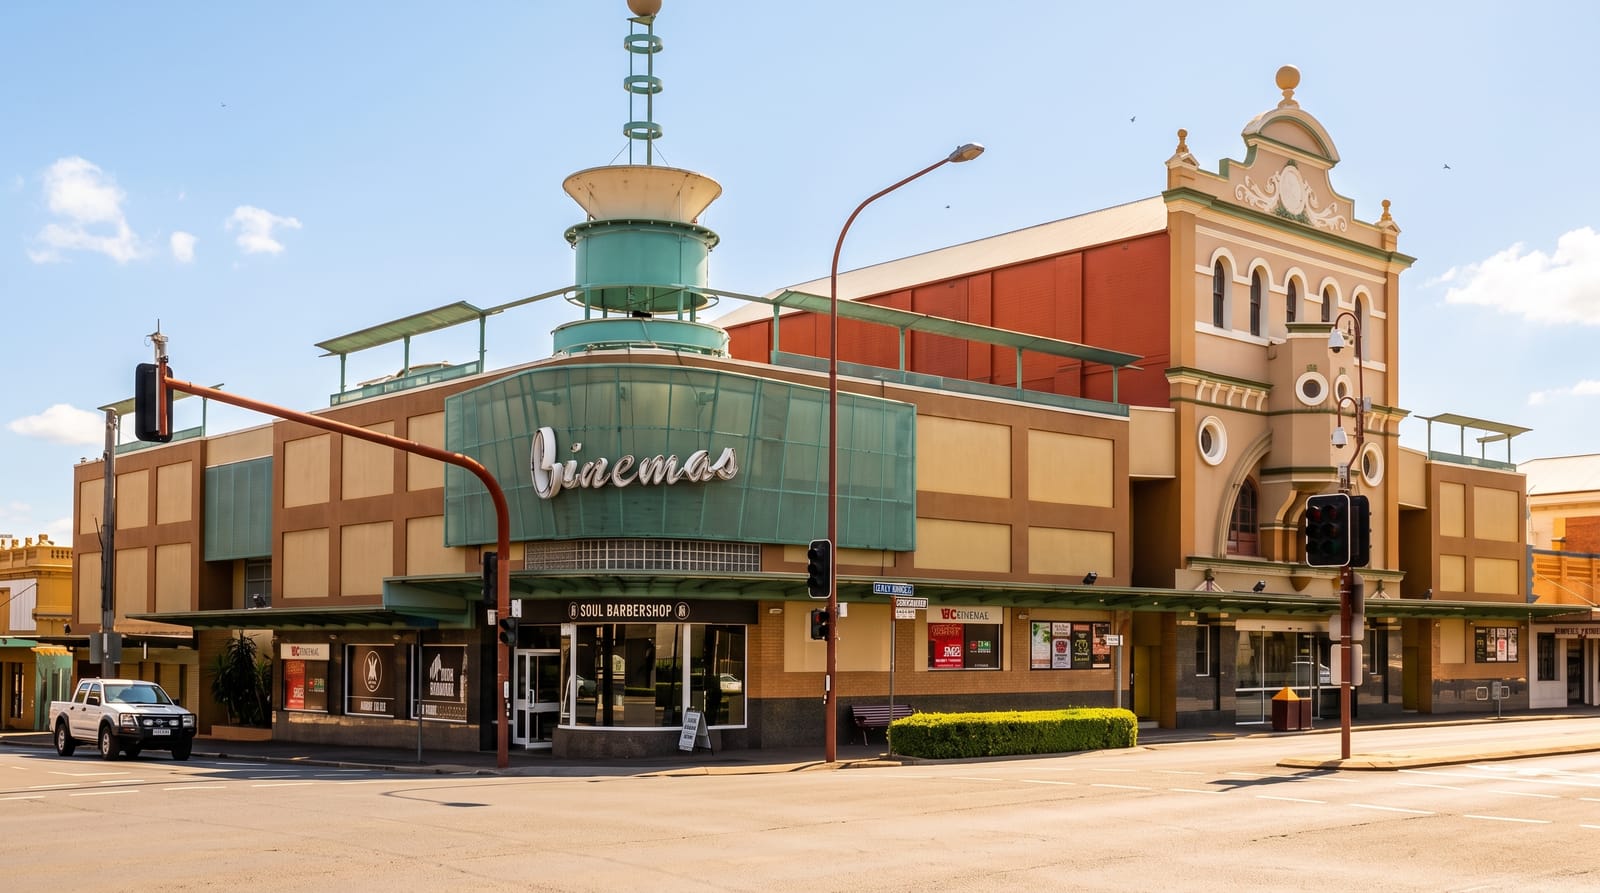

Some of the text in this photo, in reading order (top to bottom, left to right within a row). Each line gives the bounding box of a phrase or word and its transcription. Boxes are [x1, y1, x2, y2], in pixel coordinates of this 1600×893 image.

[530, 426, 739, 500] Cinemas
[580, 604, 604, 617] SOUL
[606, 604, 672, 617] BARBERSHOP
